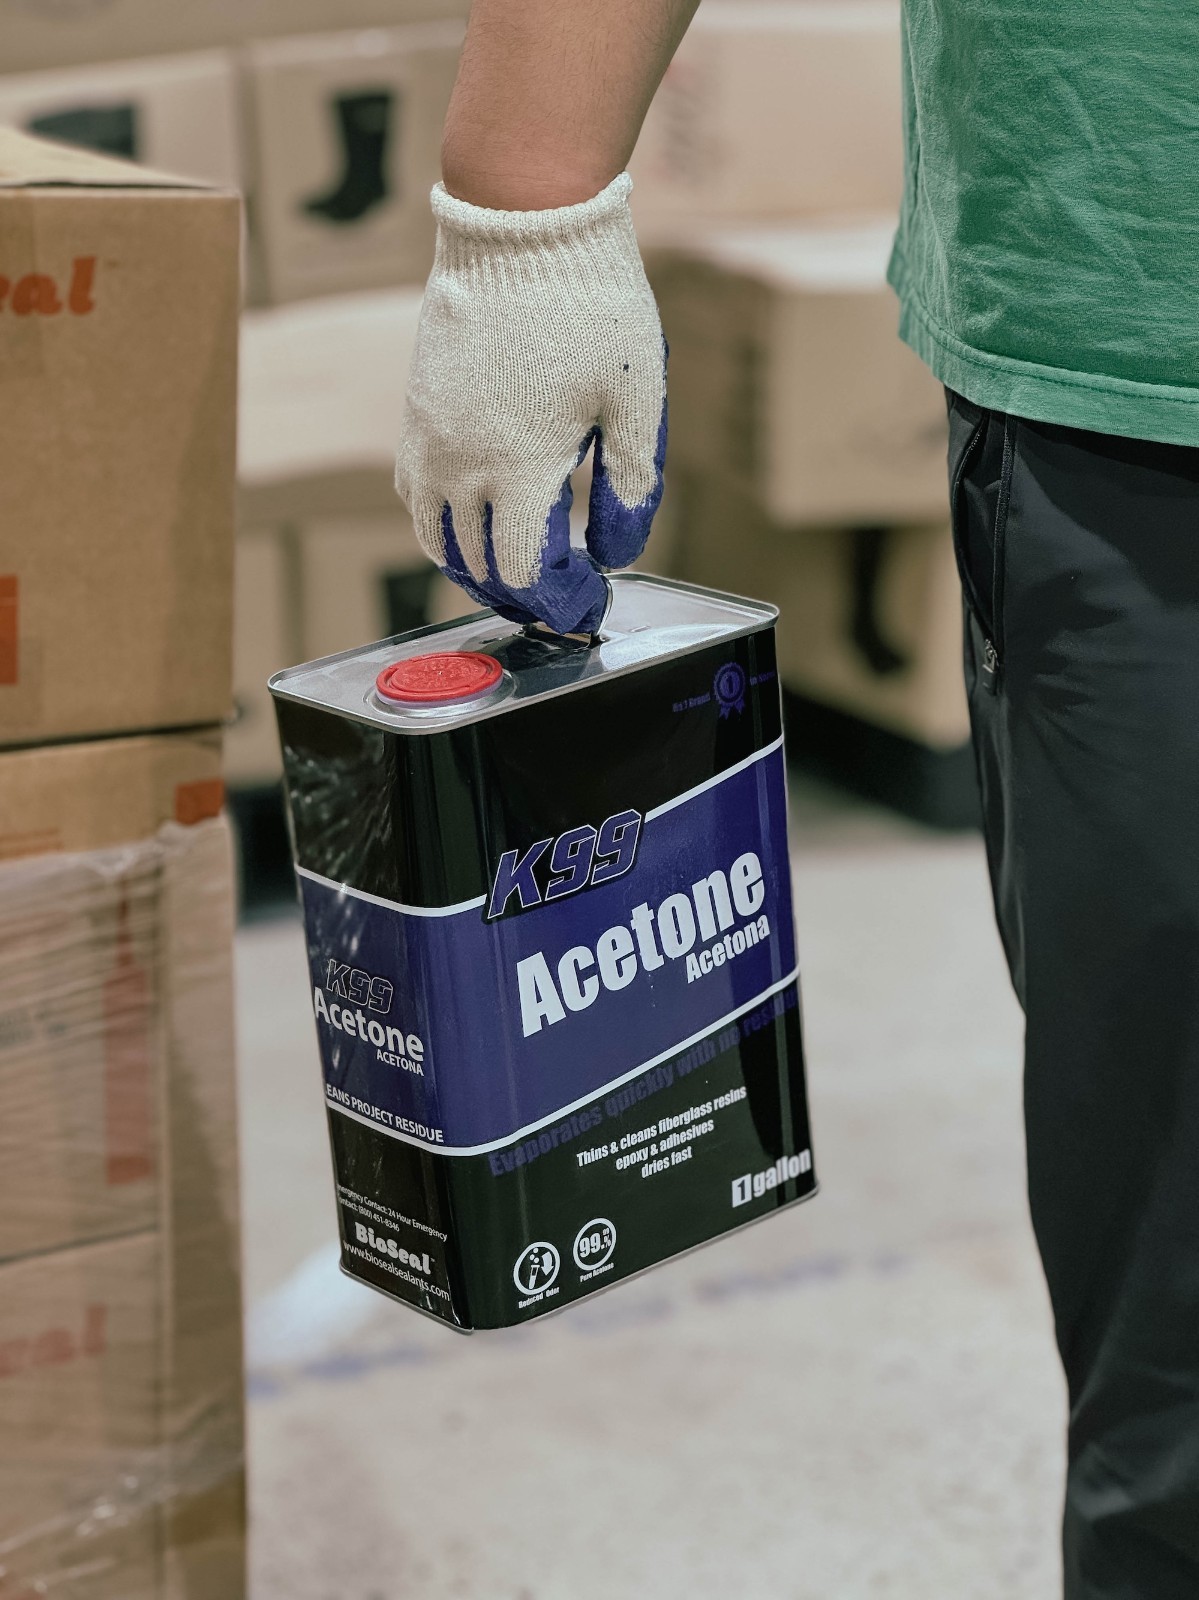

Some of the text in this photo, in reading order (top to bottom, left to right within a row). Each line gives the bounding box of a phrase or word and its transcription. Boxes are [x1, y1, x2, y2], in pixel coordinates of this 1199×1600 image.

[0, 257, 97, 315] al
[486, 808, 642, 919] K99
[516, 852, 766, 1038] Acetone
[686, 914, 771, 984] Acetona
[326, 958, 394, 1014] K99
[314, 986, 424, 1062] Acetone
[376, 1049, 424, 1077] ACETONA
[325, 1082, 444, 1143] EANS PROJECT RESIDUE
[487, 1105, 603, 1177] Evaporates
[604, 1064, 674, 1118] quickly
[675, 1038, 717, 1077] with
[576, 1086, 747, 1168] Thins & cleans fiberglass resins
[615, 1119, 715, 1171] epoxy & adhesives
[641, 1146, 693, 1179] dries fast
[753, 1148, 811, 1198] gallon
[354, 1221, 432, 1275] BioSeal
[387, 1207, 397, 1220] 24
[396, 1212, 412, 1226] Hour
[411, 1219, 448, 1243] Emergency
[343, 1240, 451, 1301] www.biosealsealants.com
[518, 1292, 544, 1309] Reduced
